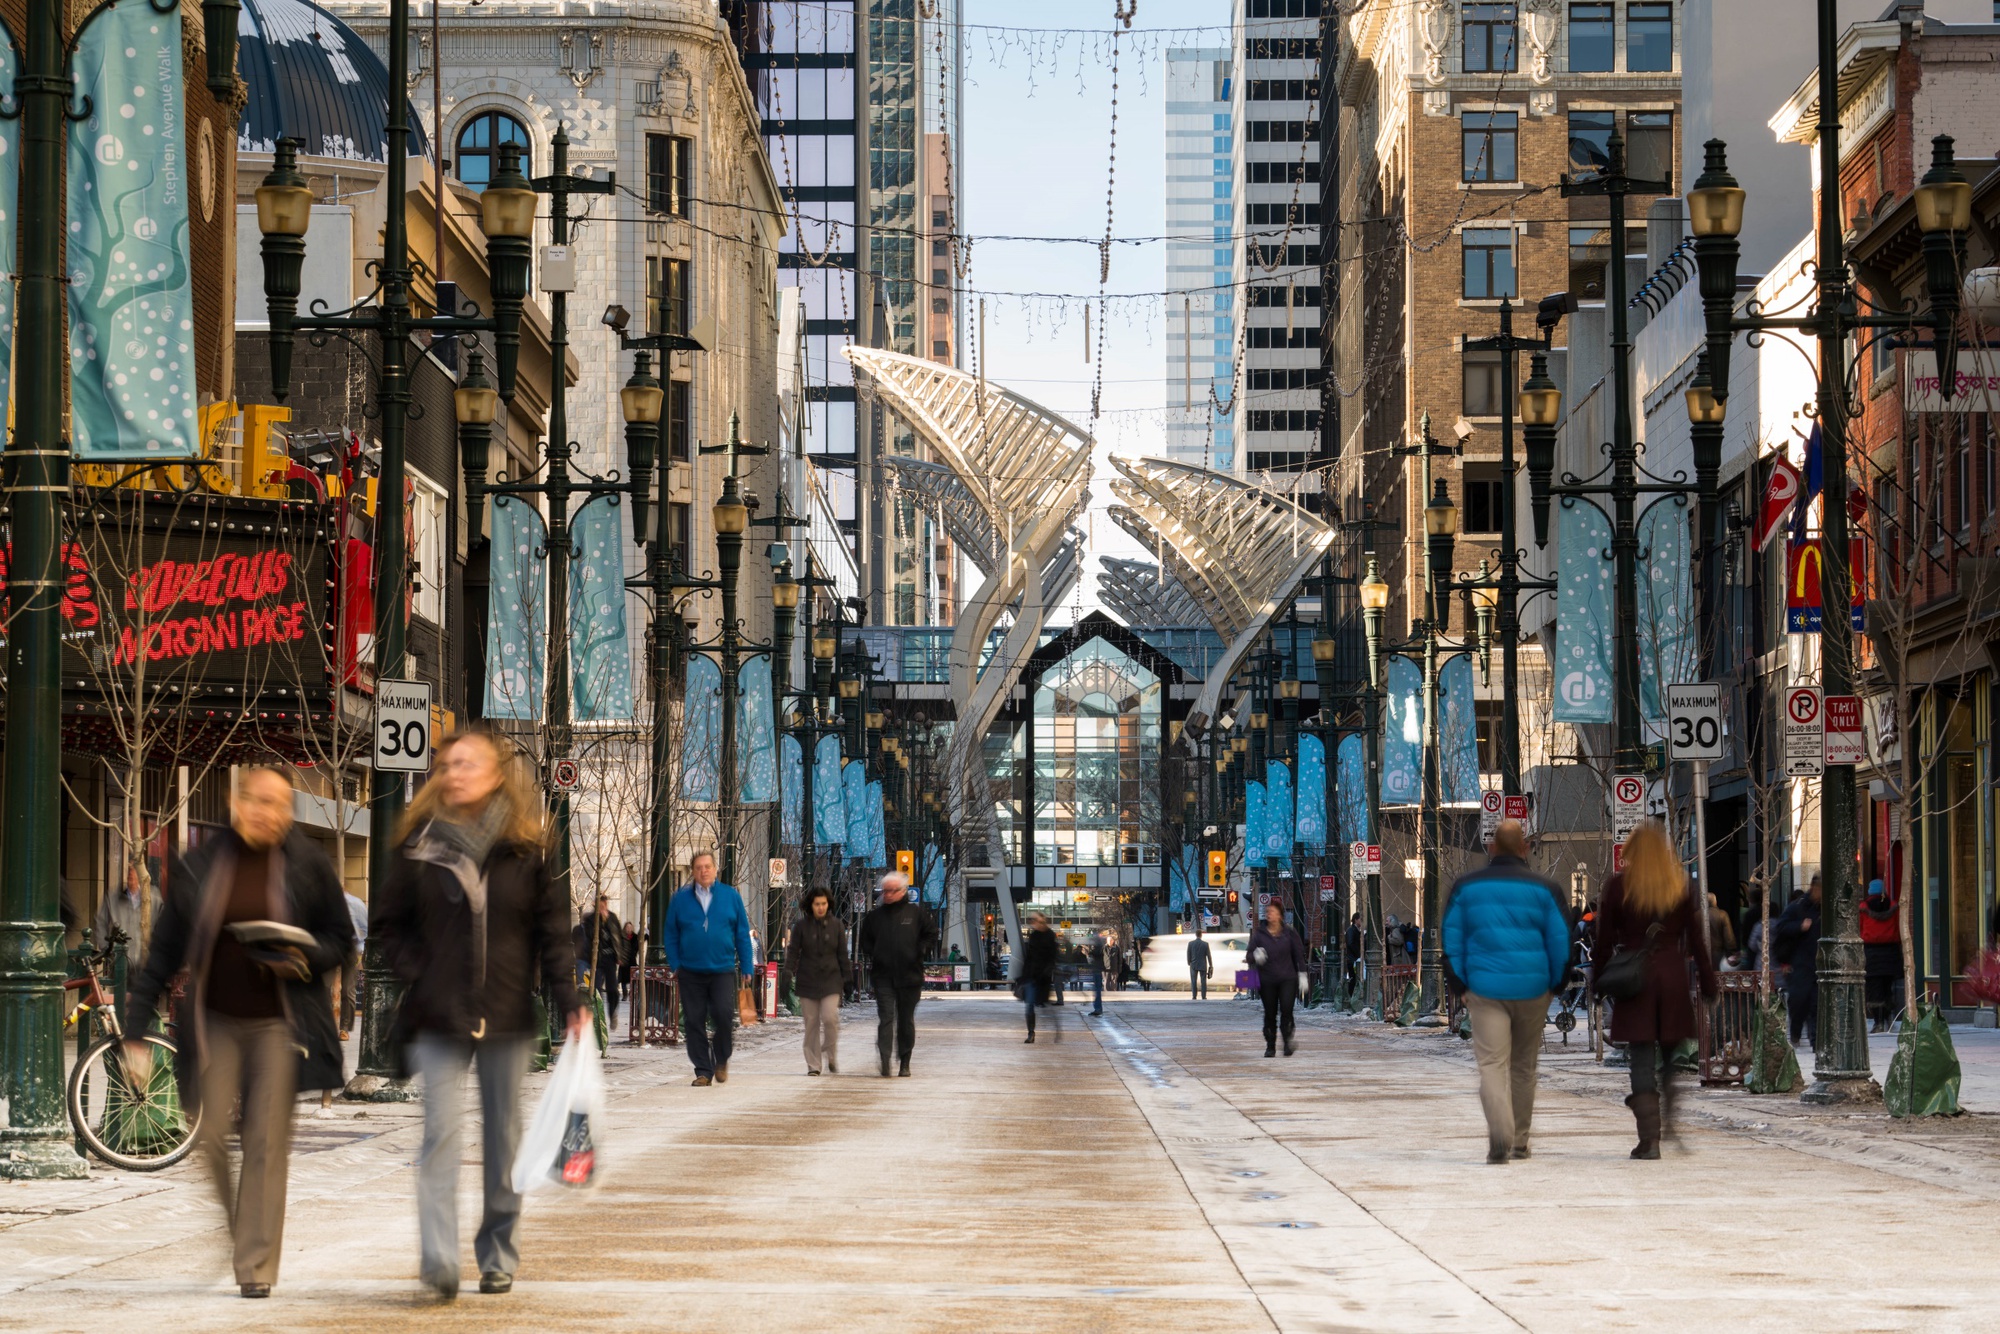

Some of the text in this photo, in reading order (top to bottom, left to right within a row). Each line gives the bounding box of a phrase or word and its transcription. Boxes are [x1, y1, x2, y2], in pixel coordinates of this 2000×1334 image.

[157, 45, 179, 205] Stephen Avenue Walk
[1845, 81, 1886, 142] BUILDING
[612, 543, 620, 571] Avenue
[613, 571, 621, 599] Stephen
[112, 601, 307, 666] MORGAN PAGE
[381, 696, 427, 711] MAXIMUM
[1671, 696, 1718, 708] MAXIMUM
[1832, 702, 1855, 713] TAXI
[1671, 716, 1719, 749] 30
[1832, 715, 1856, 727] ONLY
[379, 719, 426, 758] 30
[1827, 745, 1862, 753] 18:00-06:00
